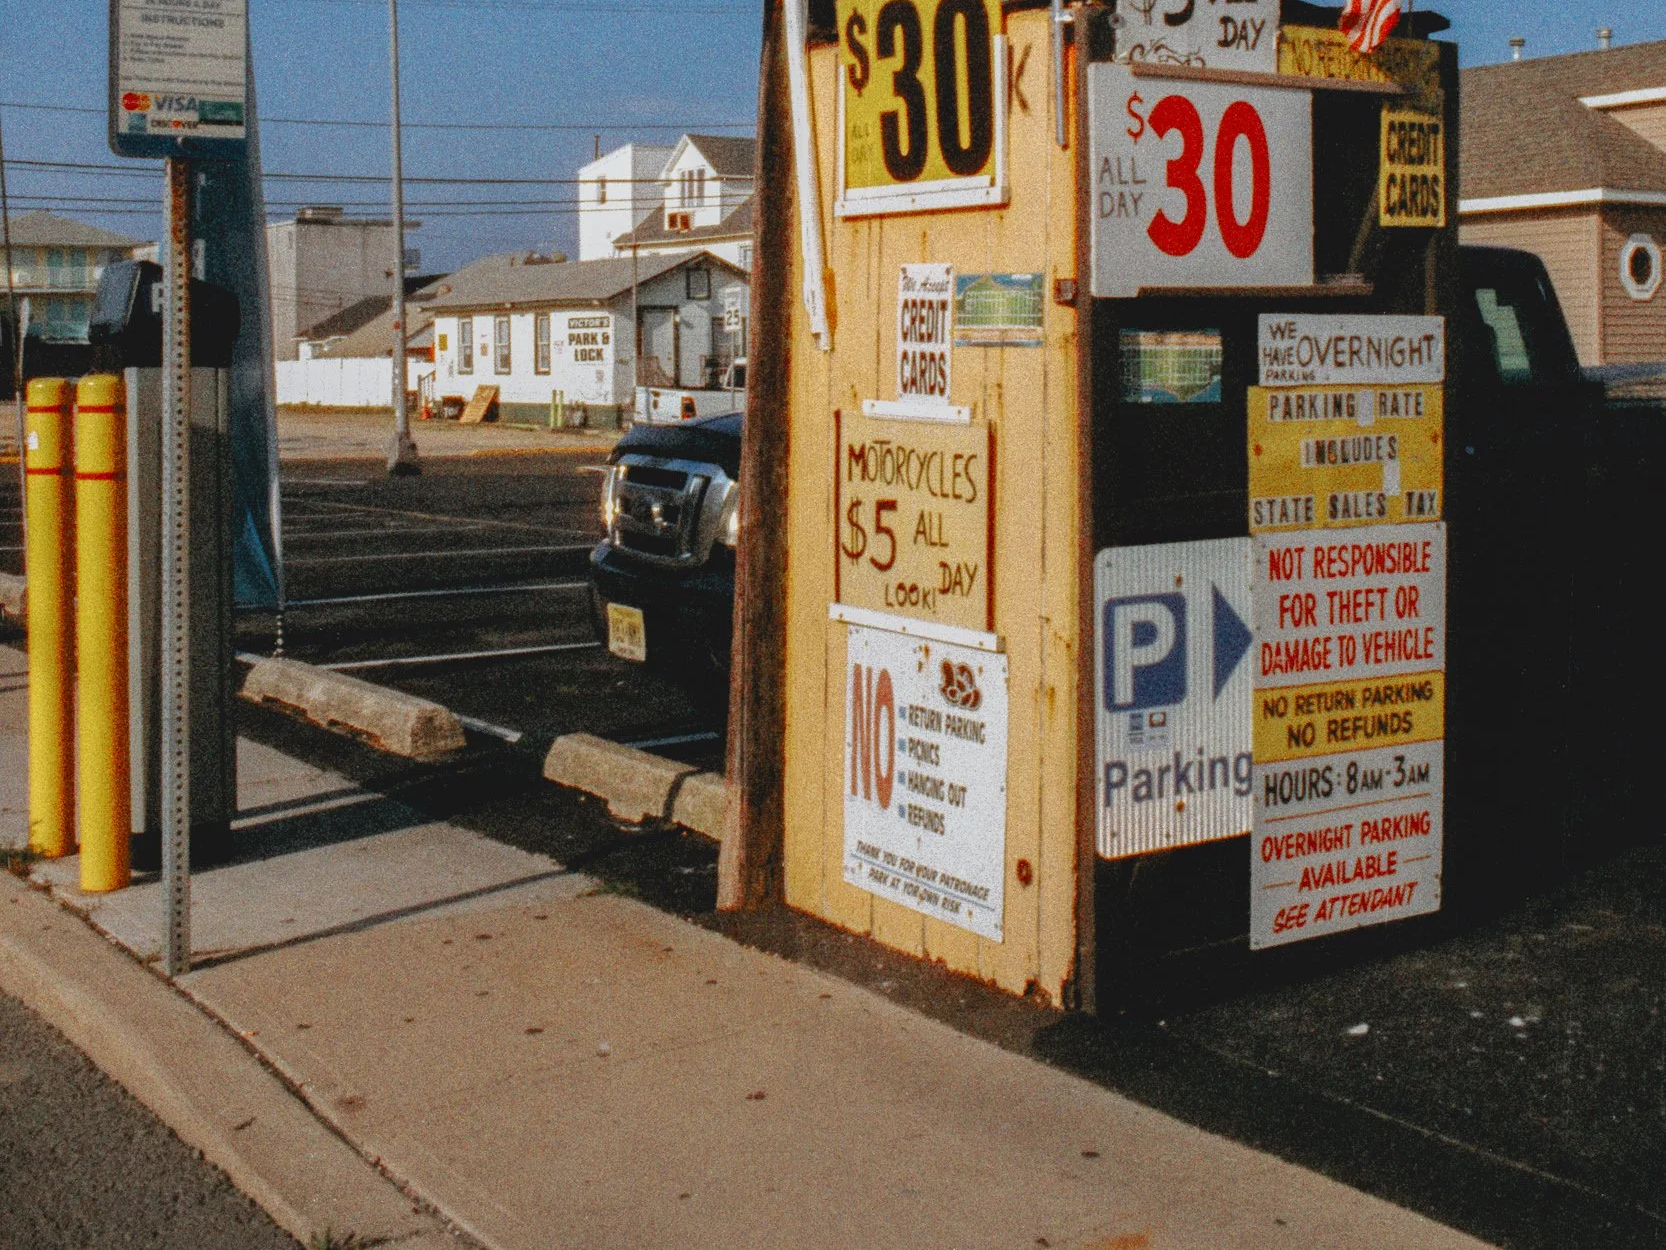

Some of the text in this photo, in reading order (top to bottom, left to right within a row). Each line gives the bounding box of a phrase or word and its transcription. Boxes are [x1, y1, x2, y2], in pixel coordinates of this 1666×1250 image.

[1217, 14, 1266, 51] DAY
[154, 95, 198, 111] VISA
[1387, 121, 1440, 167] CREDIT
[1100, 155, 1147, 185] ALL
[1126, 91, 1270, 259] $30
[1100, 191, 1144, 219] DAY
[1385, 173, 1440, 218] CARDS
[568, 333, 599, 345] PARK
[726, 310, 740, 326] 25
[901, 299, 948, 344] CREDIT
[1268, 320, 1297, 340] WE
[574, 348, 605, 361] LOCK
[1262, 333, 1434, 368] HAVE OVERNIGHT
[900, 349, 947, 397] CARDS
[1269, 392, 1423, 421] PARKING RATE
[848, 440, 978, 503] MOTORCYCLES
[1254, 491, 1437, 526] STATE SALES TAX
[842, 496, 949, 573] $5 ALL
[938, 561, 978, 597] DAY
[1269, 541, 1431, 582] NOT RESPONSIBLE
[1279, 585, 1420, 629] FOR THEFT OR
[1114, 602, 1176, 706] P
[1261, 626, 1434, 676] DAMAGE TO VEHICLE
[1262, 680, 1434, 720] NO RETURN PARKING
[851, 661, 895, 811] NO
[908, 703, 986, 746] RETURN PARKING
[1286, 710, 1414, 749] NO REFUNDS
[908, 736, 940, 767] PICNICS
[907, 770, 967, 808] HANGING OUT
[1104, 747, 1253, 809] Parking
[1261, 810, 1431, 863] OVERNIGHT PARKING
[856, 839, 990, 901] THANK YOU FOR YOUR PATRONAGE
[868, 867, 889, 885] PARK
[890, 877, 901, 890] AT
[941, 896, 962, 914] RISK
[1298, 851, 1398, 893] AVAILABLE
[1273, 882, 1419, 934] SEE ATTENDANT
